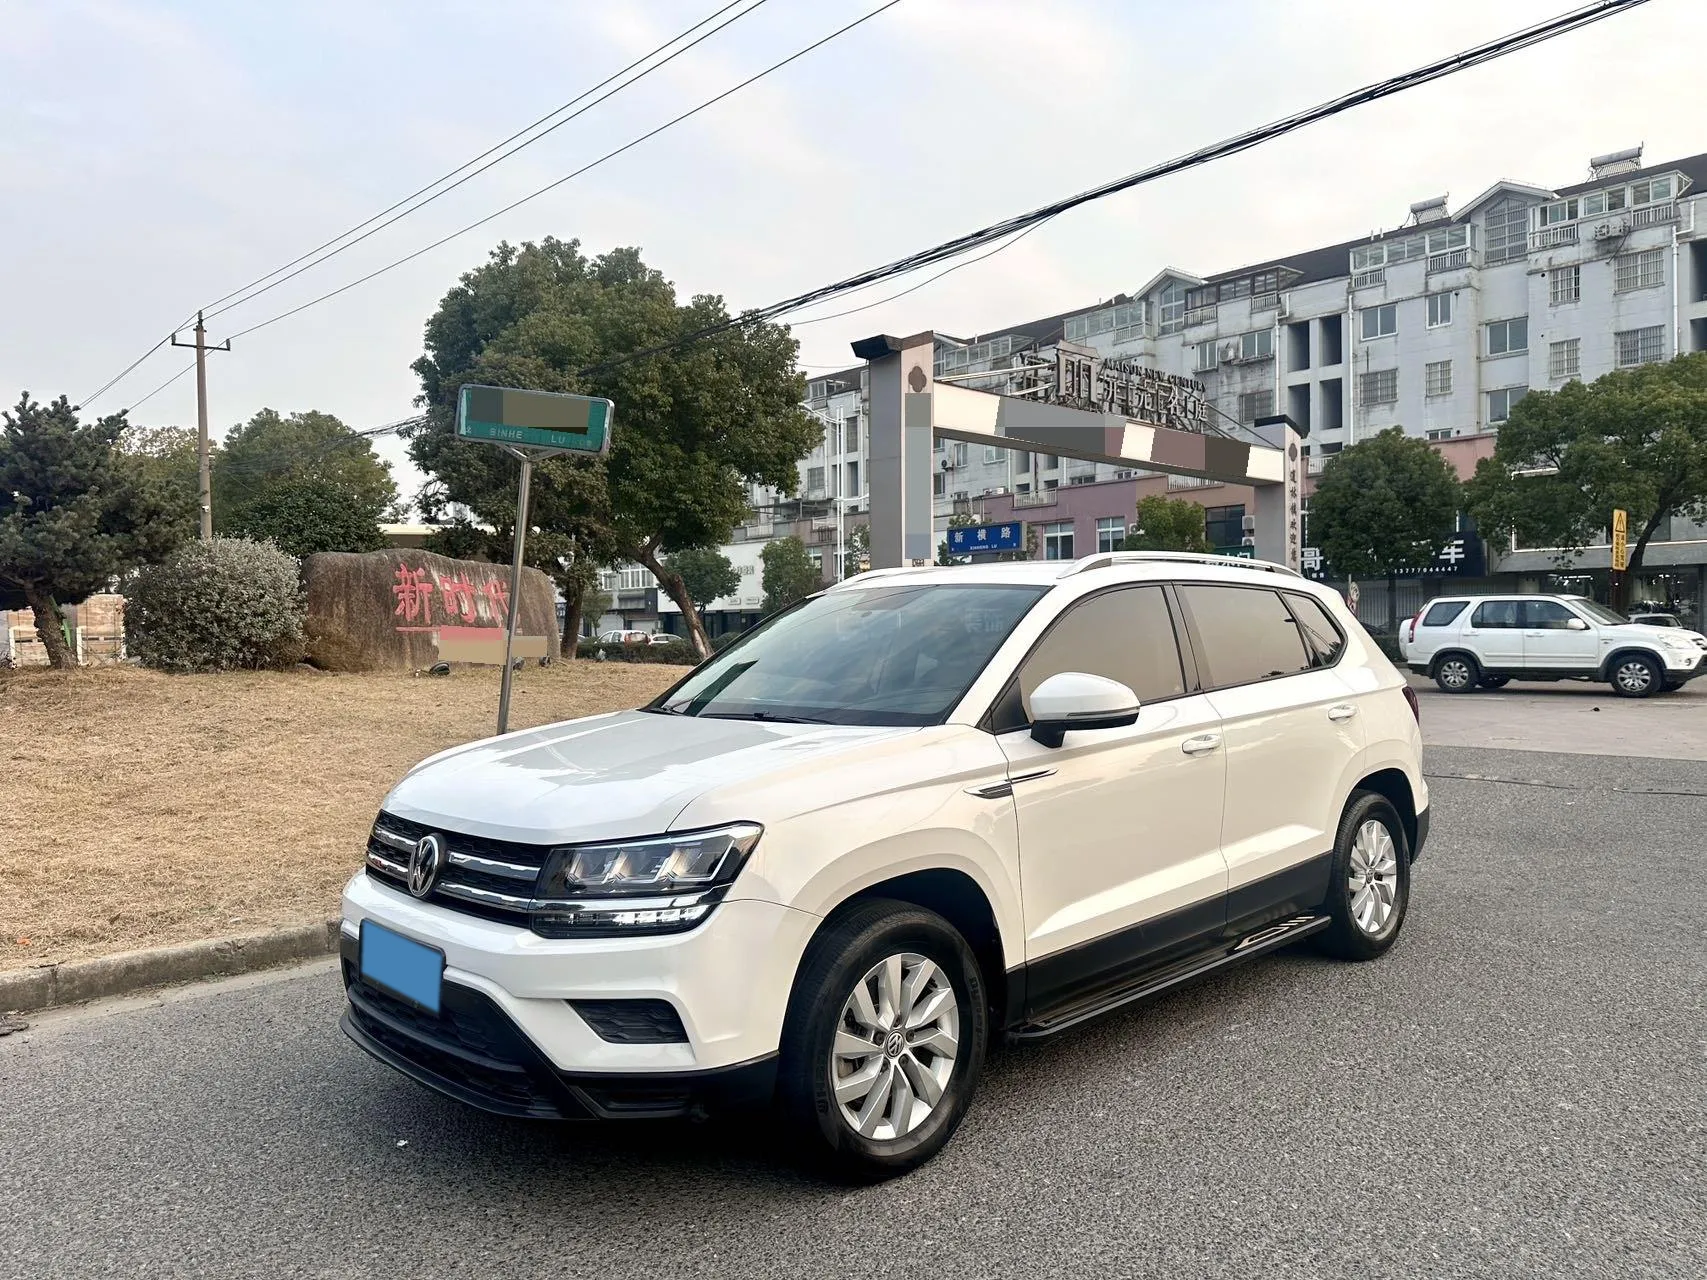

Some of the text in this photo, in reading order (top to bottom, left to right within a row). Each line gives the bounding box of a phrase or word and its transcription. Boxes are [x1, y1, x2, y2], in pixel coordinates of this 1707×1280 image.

[551, 436, 566, 444] LU
[954, 526, 1011, 543] 新横路
[1301, 547, 1324, 571] 哥
